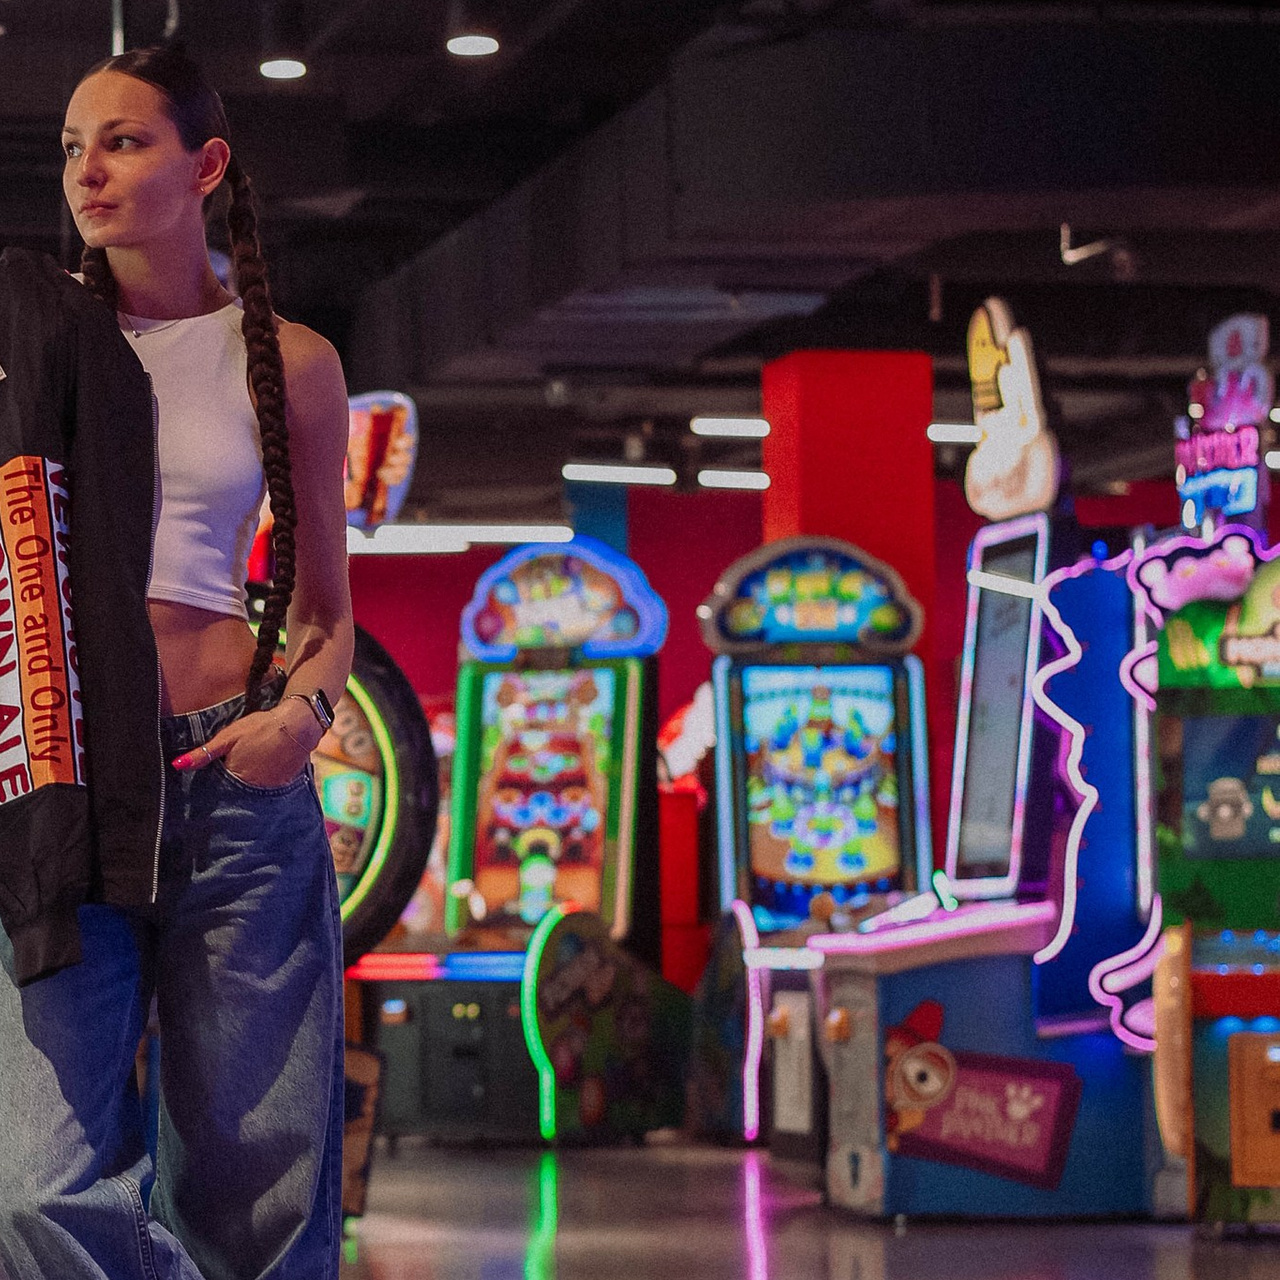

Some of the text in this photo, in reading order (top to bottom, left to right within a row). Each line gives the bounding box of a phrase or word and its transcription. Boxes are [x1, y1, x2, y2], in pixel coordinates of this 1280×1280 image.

[4, 463, 42, 526] The
[15, 534, 50, 603] One
[23, 612, 63, 676] and
[30, 685, 69, 764] Only
